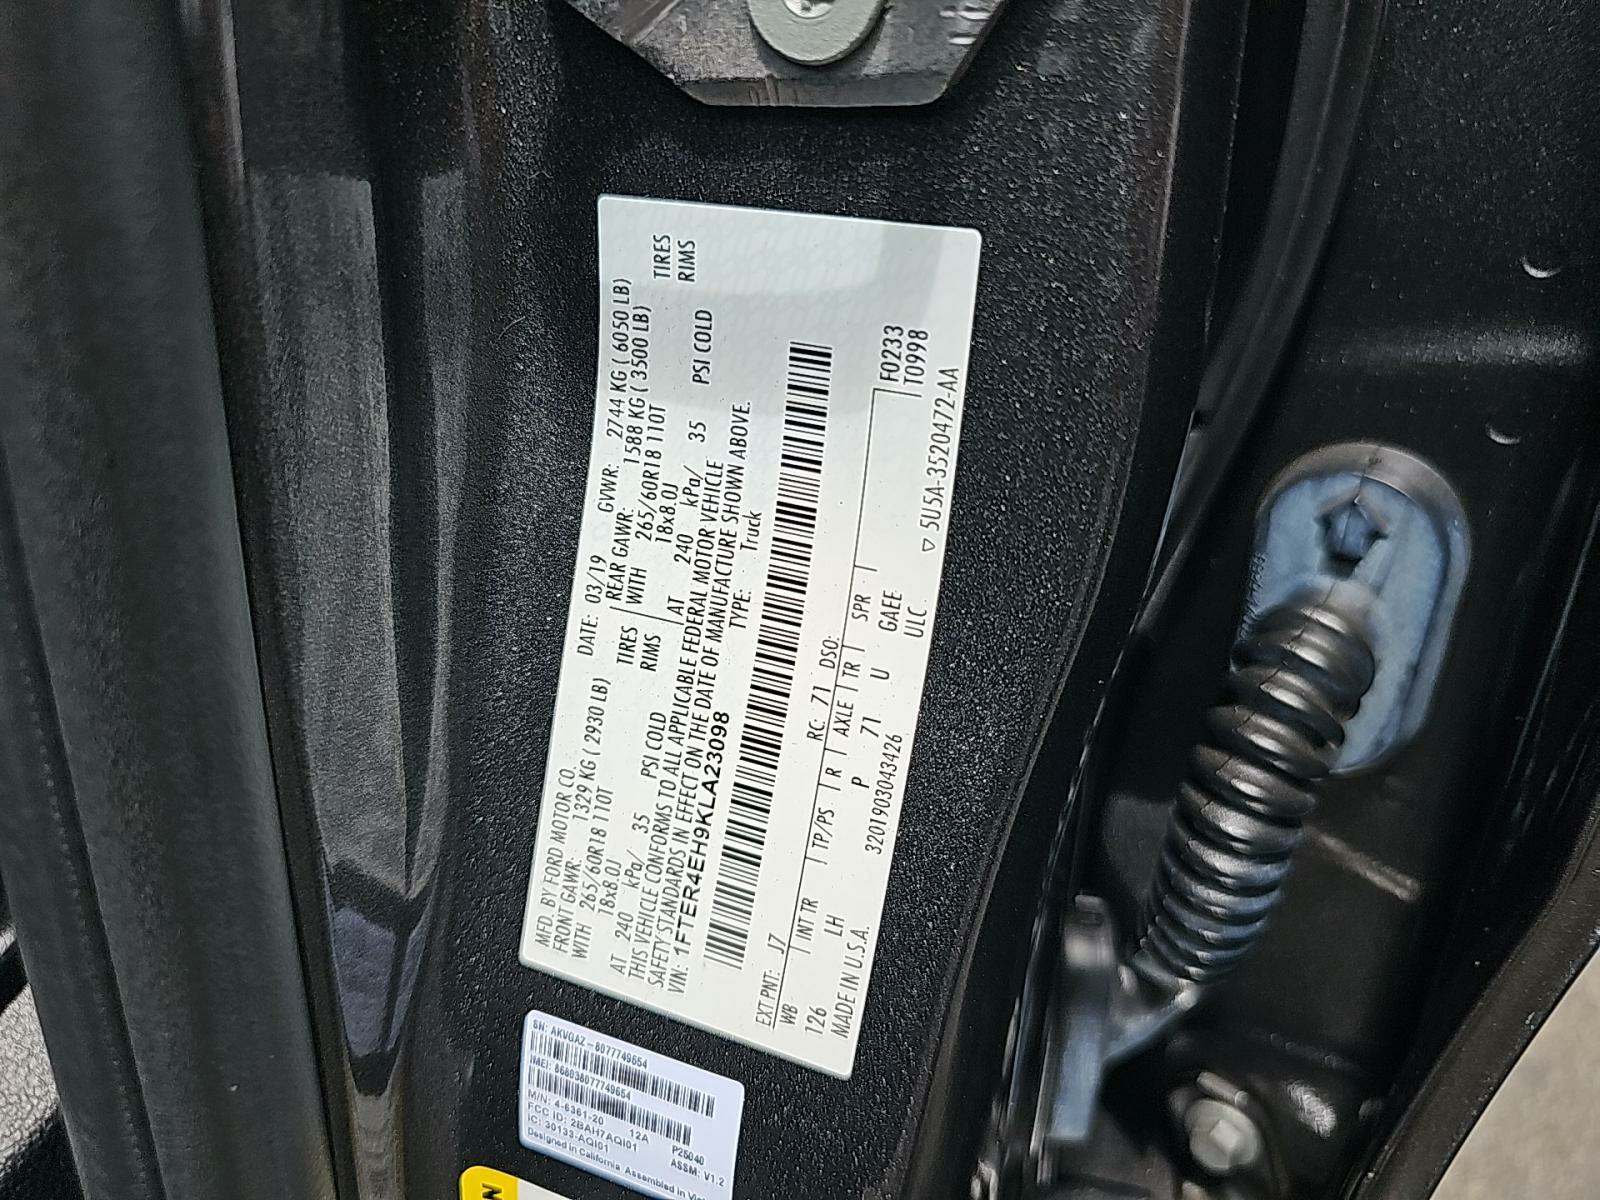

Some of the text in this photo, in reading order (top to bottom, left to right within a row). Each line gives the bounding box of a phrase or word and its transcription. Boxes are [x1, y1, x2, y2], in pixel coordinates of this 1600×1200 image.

[653, 235, 671, 279] TIRES
[678, 240, 696, 282] RIMS
[613, 278, 632, 305] LB)
[612, 310, 630, 352] 6050
[633, 305, 652, 332] LB)
[631, 337, 649, 381] 3500
[880, 325, 904, 382] F0233
[904, 329, 928, 385] T0998
[610, 370, 628, 393] KG
[607, 398, 625, 439] 2744
[628, 397, 646, 420] KG
[624, 424, 643, 464] 1588
[667, 309, 713, 617] AT 240 kPa/ 35 PSI COLD
[598, 464, 619, 513] GVWR:
[626, 403, 666, 605] WITH 265/60R18 110T
[656, 482, 679, 543] 18x8.0J
[612, 507, 634, 558] GAWR:
[606, 562, 627, 601] REAR
[729, 510, 762, 629] TYPE: Truck
[577, 554, 607, 656] DATE: 03/19
[617, 625, 638, 665] TIRES
[640, 633, 661, 672] RIMS
[591, 677, 611, 703] LB)
[648, 402, 750, 988] SAFETY STANDARDS IN EFFECT ON THE DATE OF MANUFACTURE SHOWN ABOVE.
[807, 636, 843, 742] RC: 71 DSO:
[831, 368, 958, 1039] MADE IN U.S.A. 3201903043426 ULC 5U5A-3520472-AA
[584, 705, 605, 745] 2930
[629, 460, 724, 980] THIS VEHICLE CONFORMS TO ALL APPLICABLE FEDERAL MOTOR VEHICLE
[579, 759, 597, 781] KG
[573, 784, 593, 821] 1329
[780, 594, 871, 1025] WB INT TR TP/PS R AXLE TR SPR
[805, 590, 903, 1035] 126 LH P 71 U GAEE
[536, 766, 577, 947] MFD. BY FORD MOTOR CO.
[610, 711, 667, 975] AT 240 kPa/ 35 PSI COLD
[668, 712, 729, 994] VIN: 1FTER4EH9KLA23098
[561, 857, 582, 904] GAWR:
[572, 785, 613, 959] WITH 265/60R18 110T
[599, 859, 622, 916] 18x8.0J
[553, 905, 574, 953] FRONT
[756, 932, 786, 1027] EXT PNT: J7
[527, 1101, 550, 1117] FCC
[552, 1110, 568, 1124] ID:
[554, 1100, 604, 1126] 4-6361-20
[629, 1128, 649, 1145] 12A
[527, 1126, 568, 1150] Designed
[579, 1147, 621, 1171] California
[624, 1166, 675, 1194] Assembled
[670, 1158, 725, 1188] ASSM: V1.2
